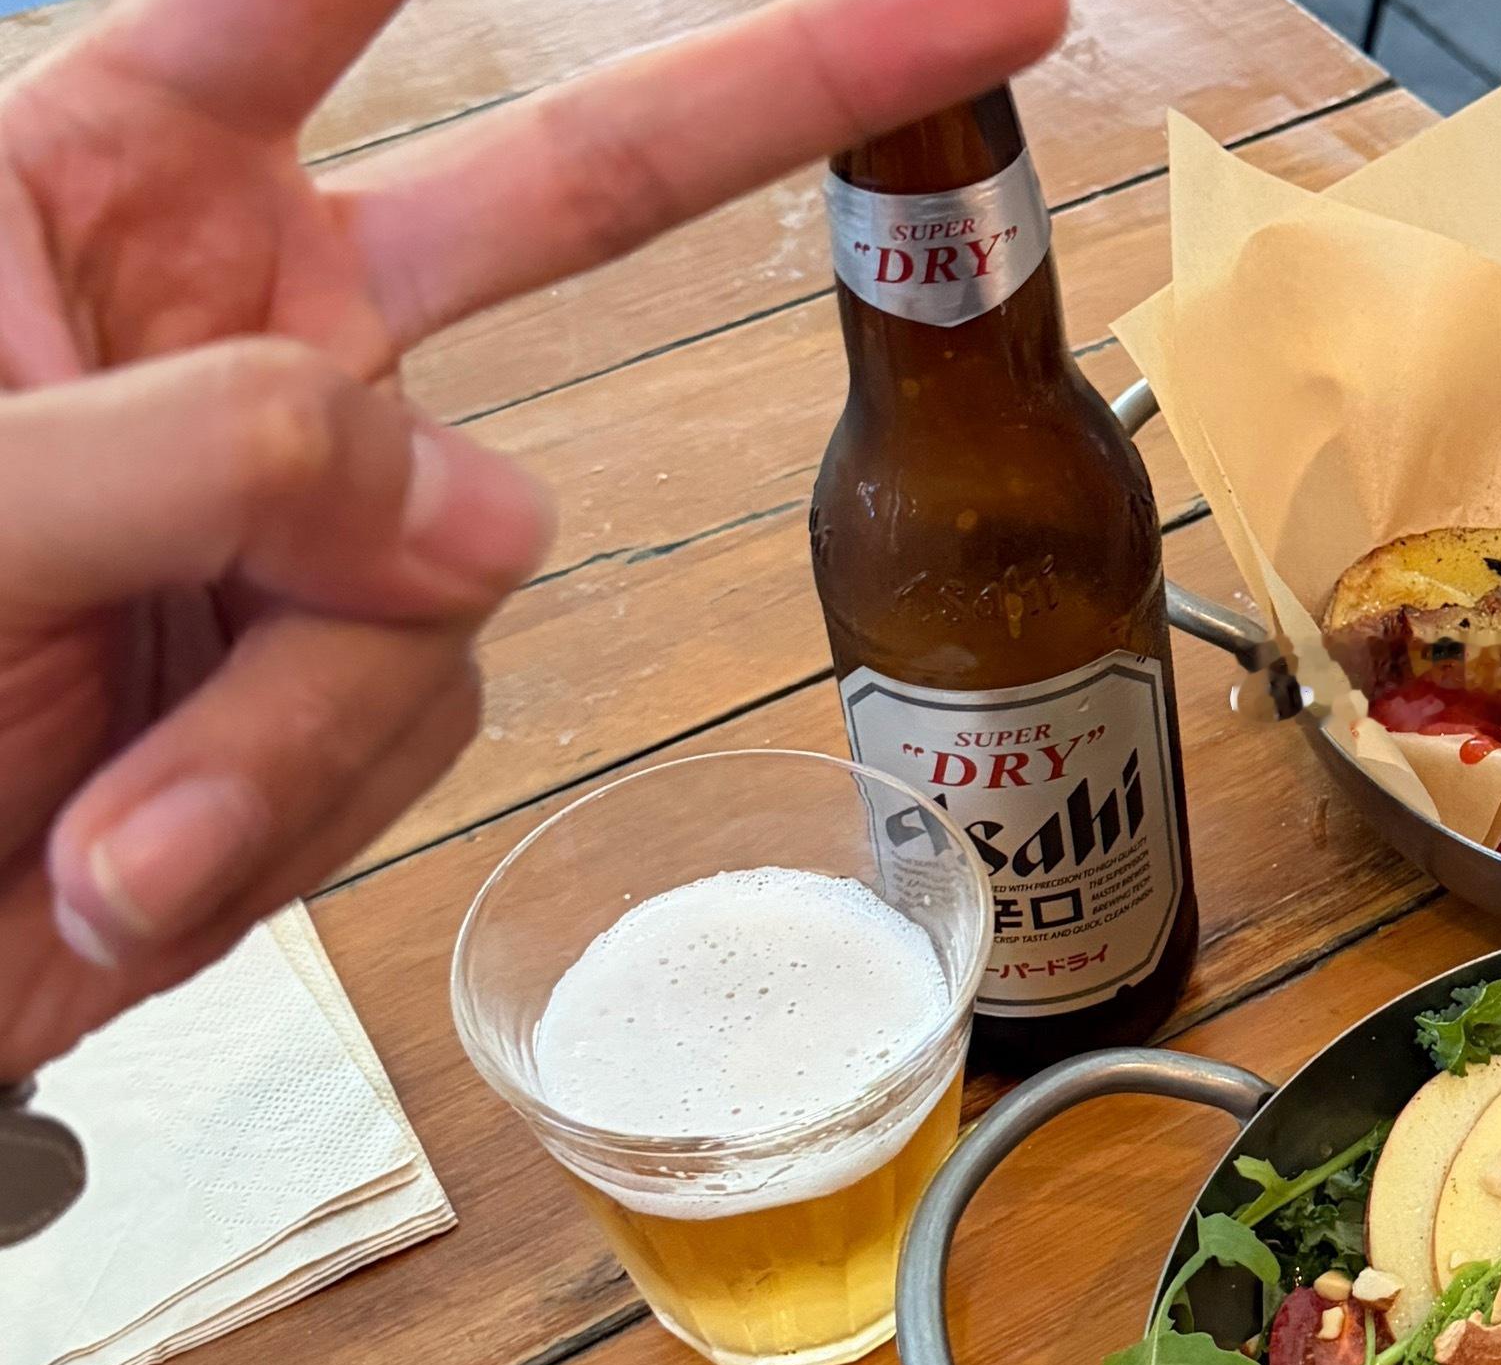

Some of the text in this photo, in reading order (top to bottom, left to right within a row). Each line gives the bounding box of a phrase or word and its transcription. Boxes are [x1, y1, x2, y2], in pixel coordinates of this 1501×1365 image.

[894, 218, 976, 242] SUPER
[954, 723, 1052, 748] SUPER
[1034, 872, 1083, 891] PRECISION
[1084, 867, 1095, 878] TO
[1118, 835, 1147, 862] QUALITY
[1091, 882, 1121, 902] MASTER
[1092, 889, 1131, 915] BREWING
[1022, 933, 1048, 943] TASTE
[1050, 929, 1072, 940] AND
[1104, 902, 1130, 923] CLEAN
